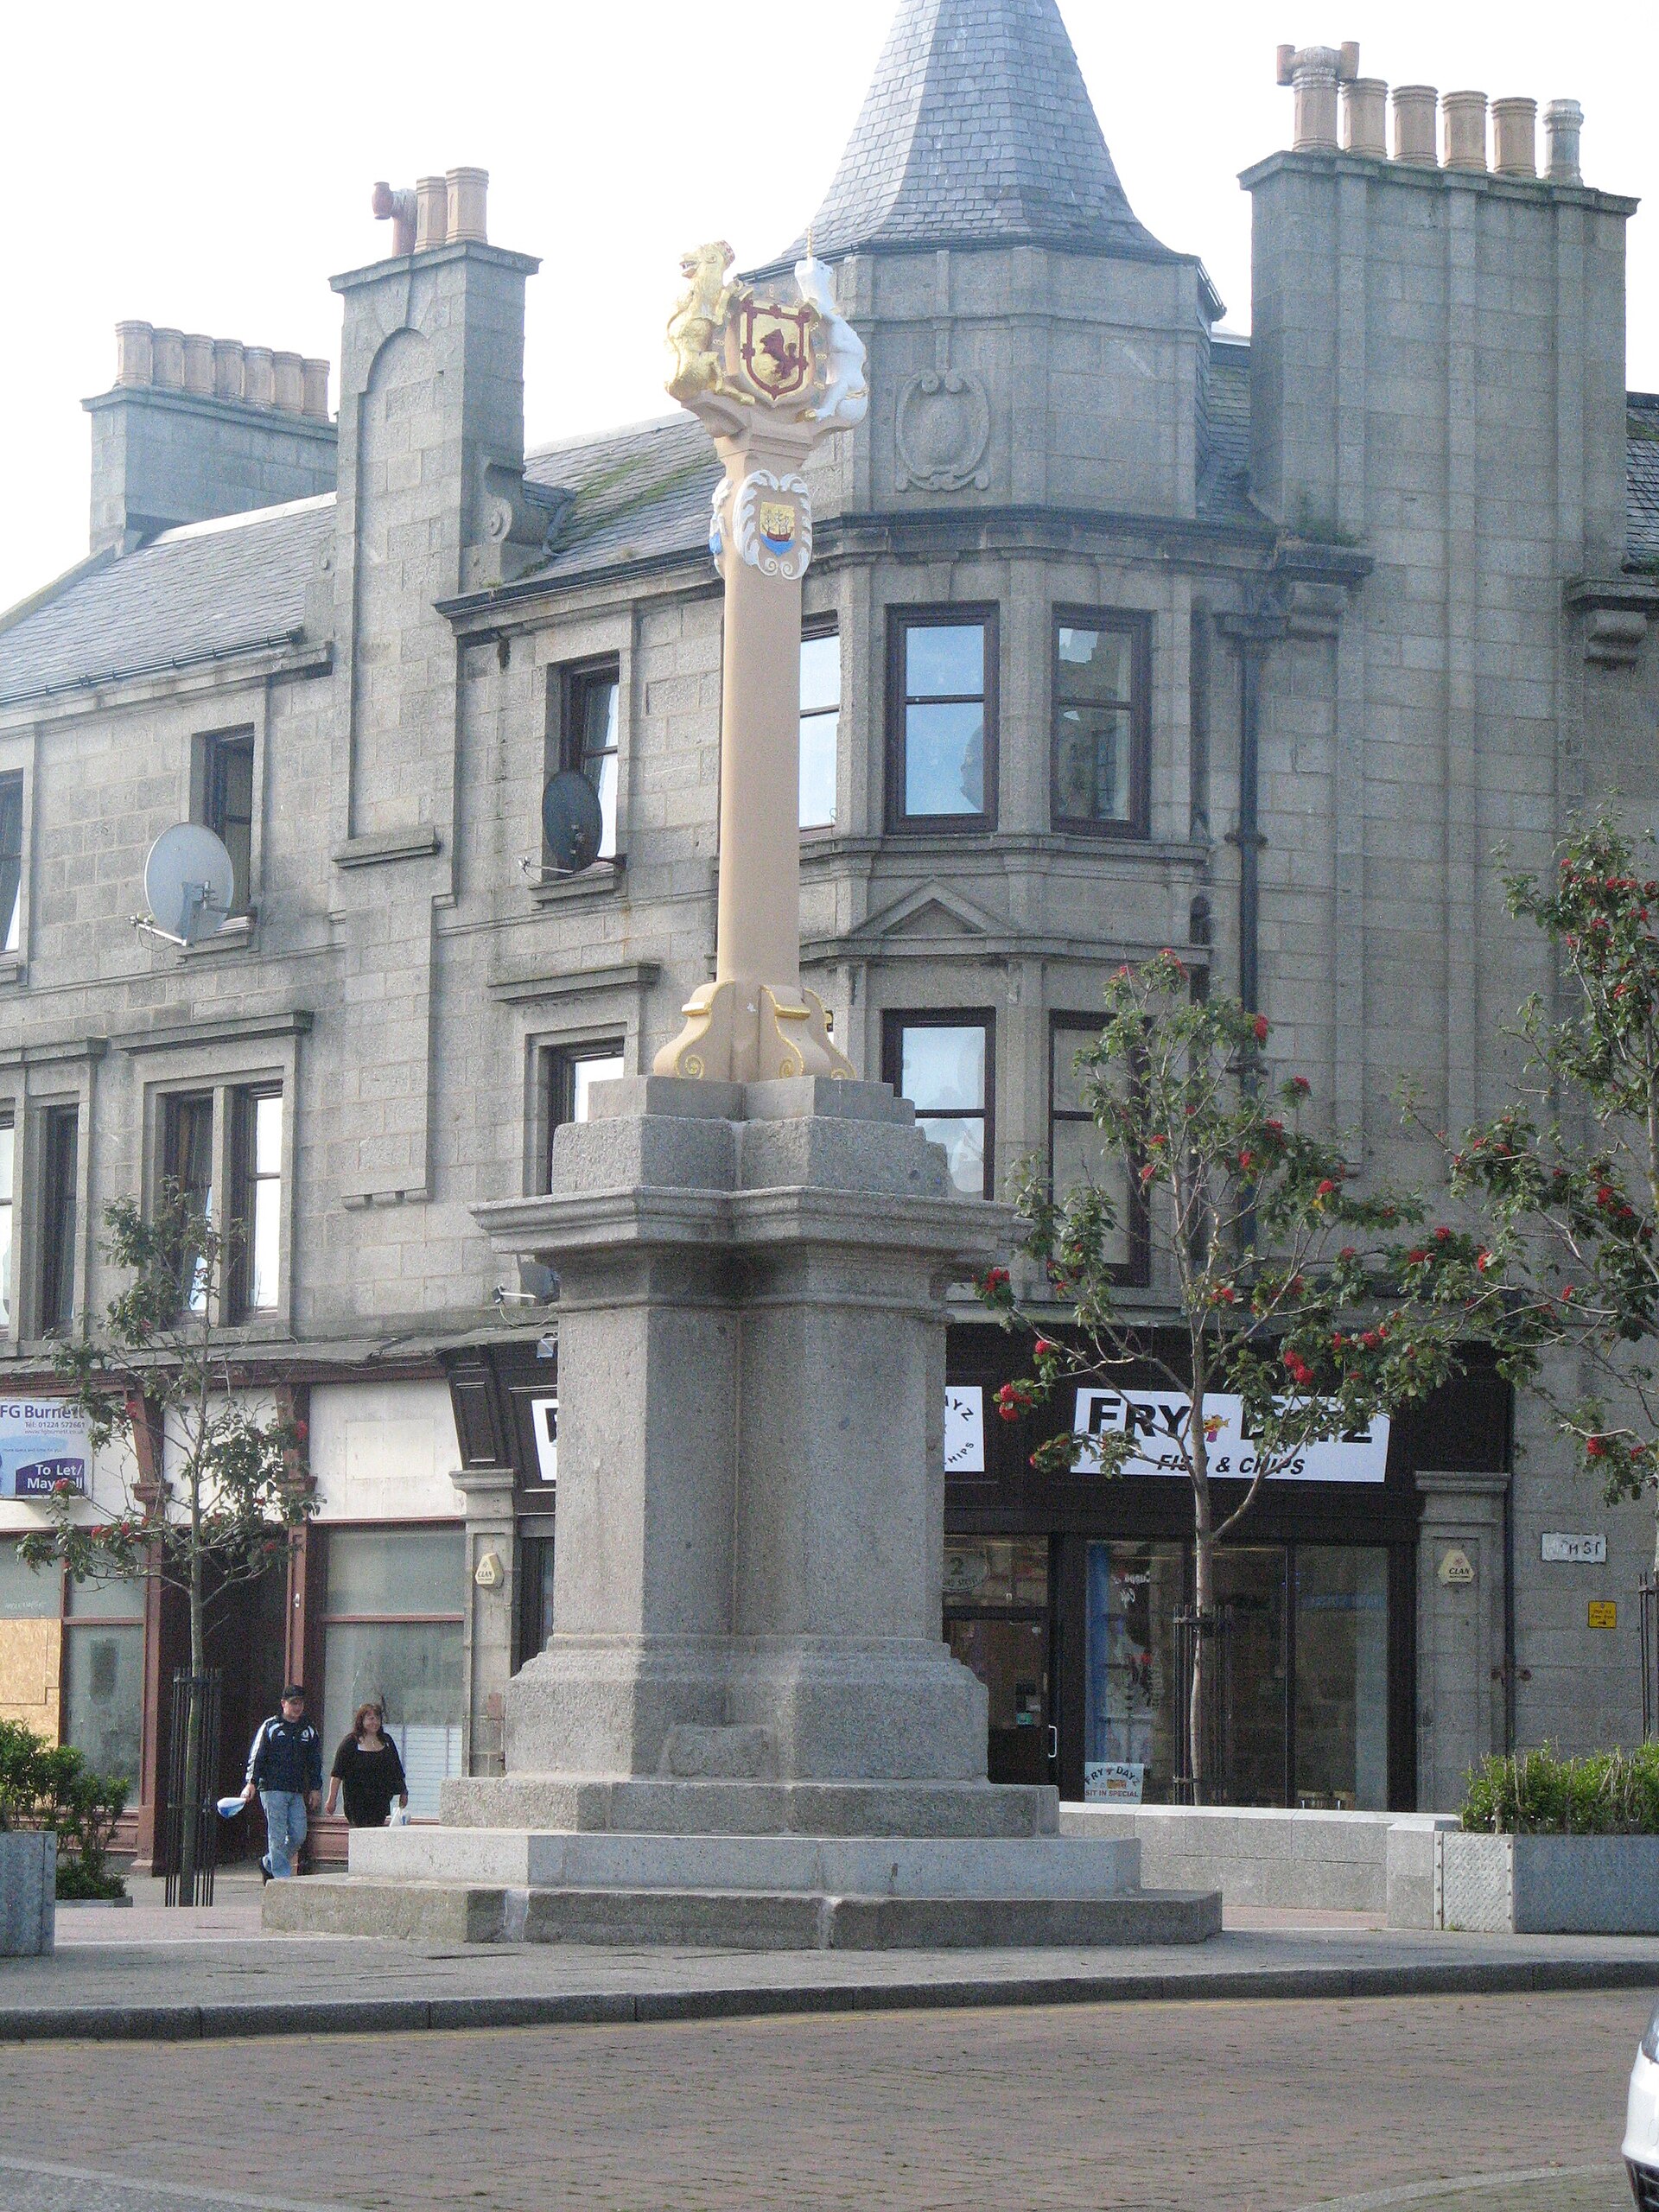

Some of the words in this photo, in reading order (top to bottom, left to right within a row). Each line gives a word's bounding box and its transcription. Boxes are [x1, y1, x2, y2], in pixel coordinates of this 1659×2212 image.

[0, 1405, 20, 1418] FG
[24, 1405, 85, 1418] Burnet
[1089, 1397, 1191, 1437] FRY
[944, 1442, 974, 1465] HIPS
[35, 1465, 51, 1475] To
[56, 1464, 83, 1476] Let/
[1157, 1454, 1210, 1471] FIS
[1216, 1456, 1230, 1473] &
[1239, 1457, 1305, 1474] CHIPS
[27, 1478, 54, 1491] May
